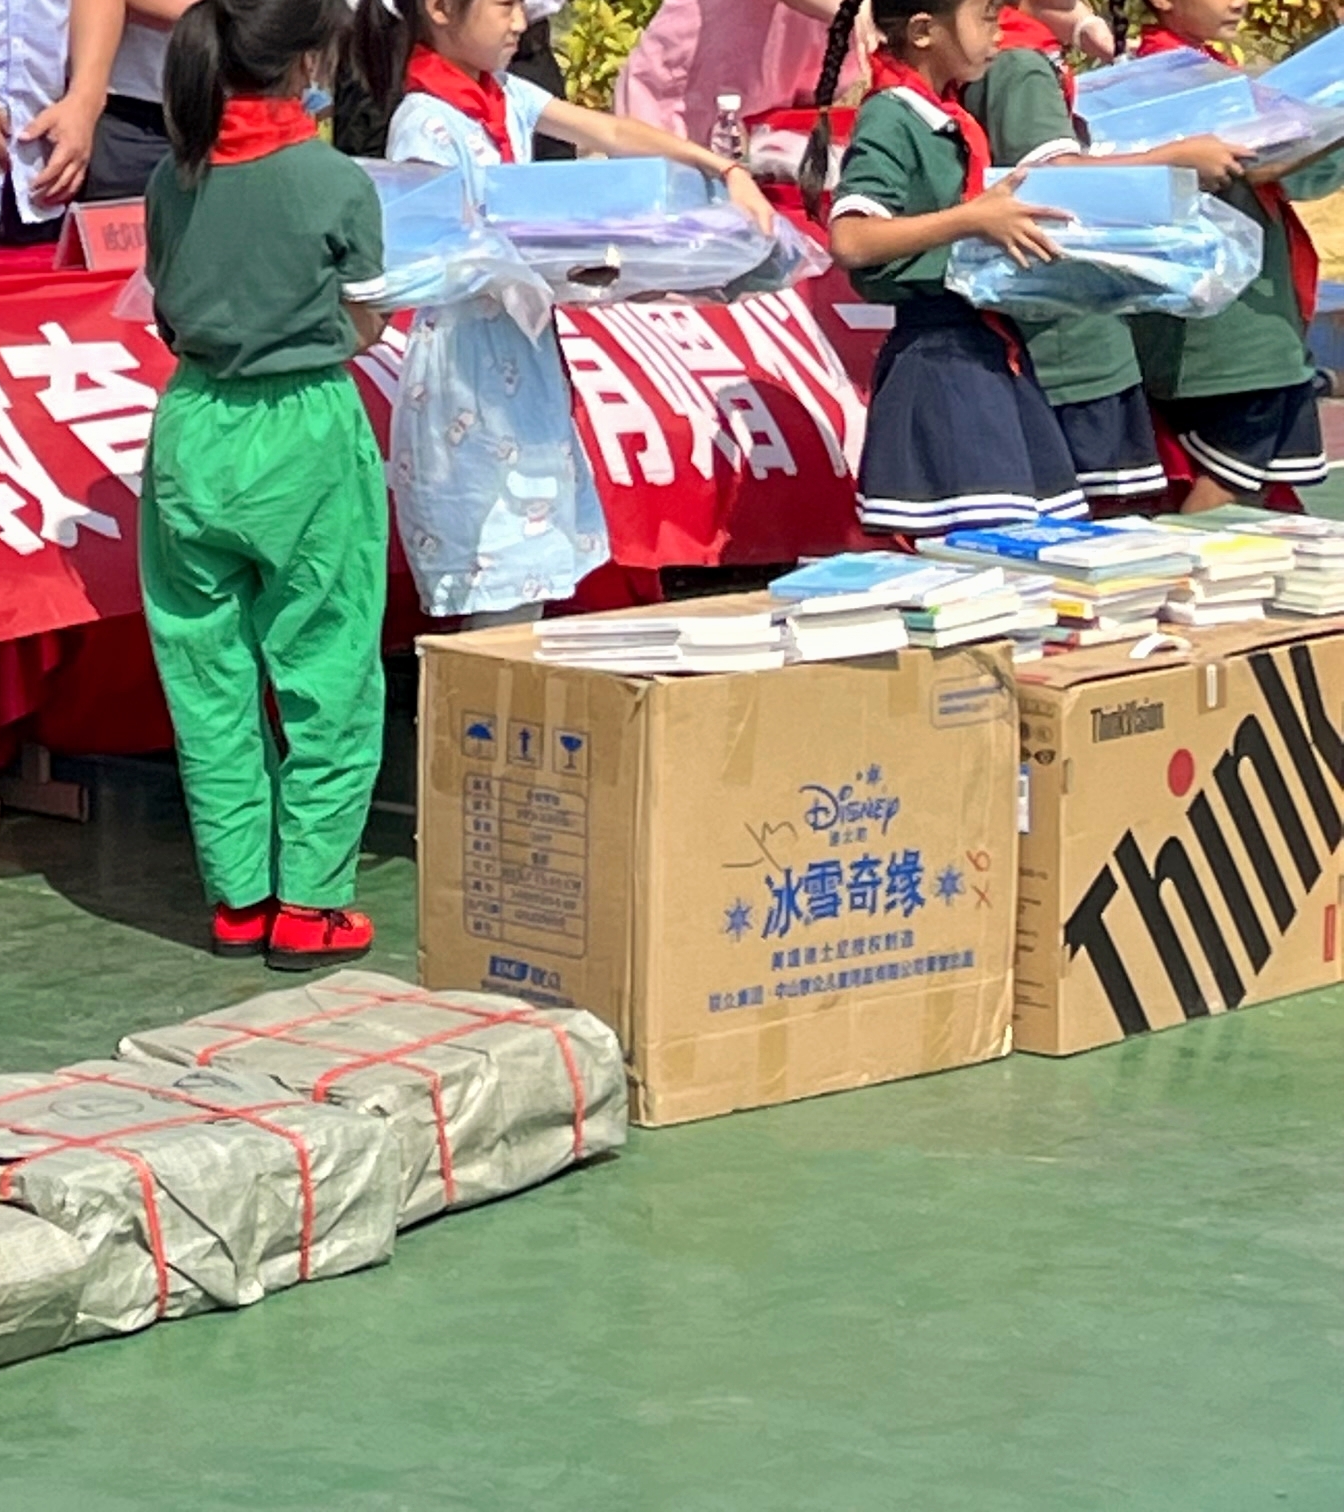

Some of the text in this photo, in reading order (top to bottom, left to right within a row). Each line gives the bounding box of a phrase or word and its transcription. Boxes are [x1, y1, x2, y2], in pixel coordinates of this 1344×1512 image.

[797, 784, 901, 837] Disney
[761, 849, 927, 939] 冰雪奇缘
